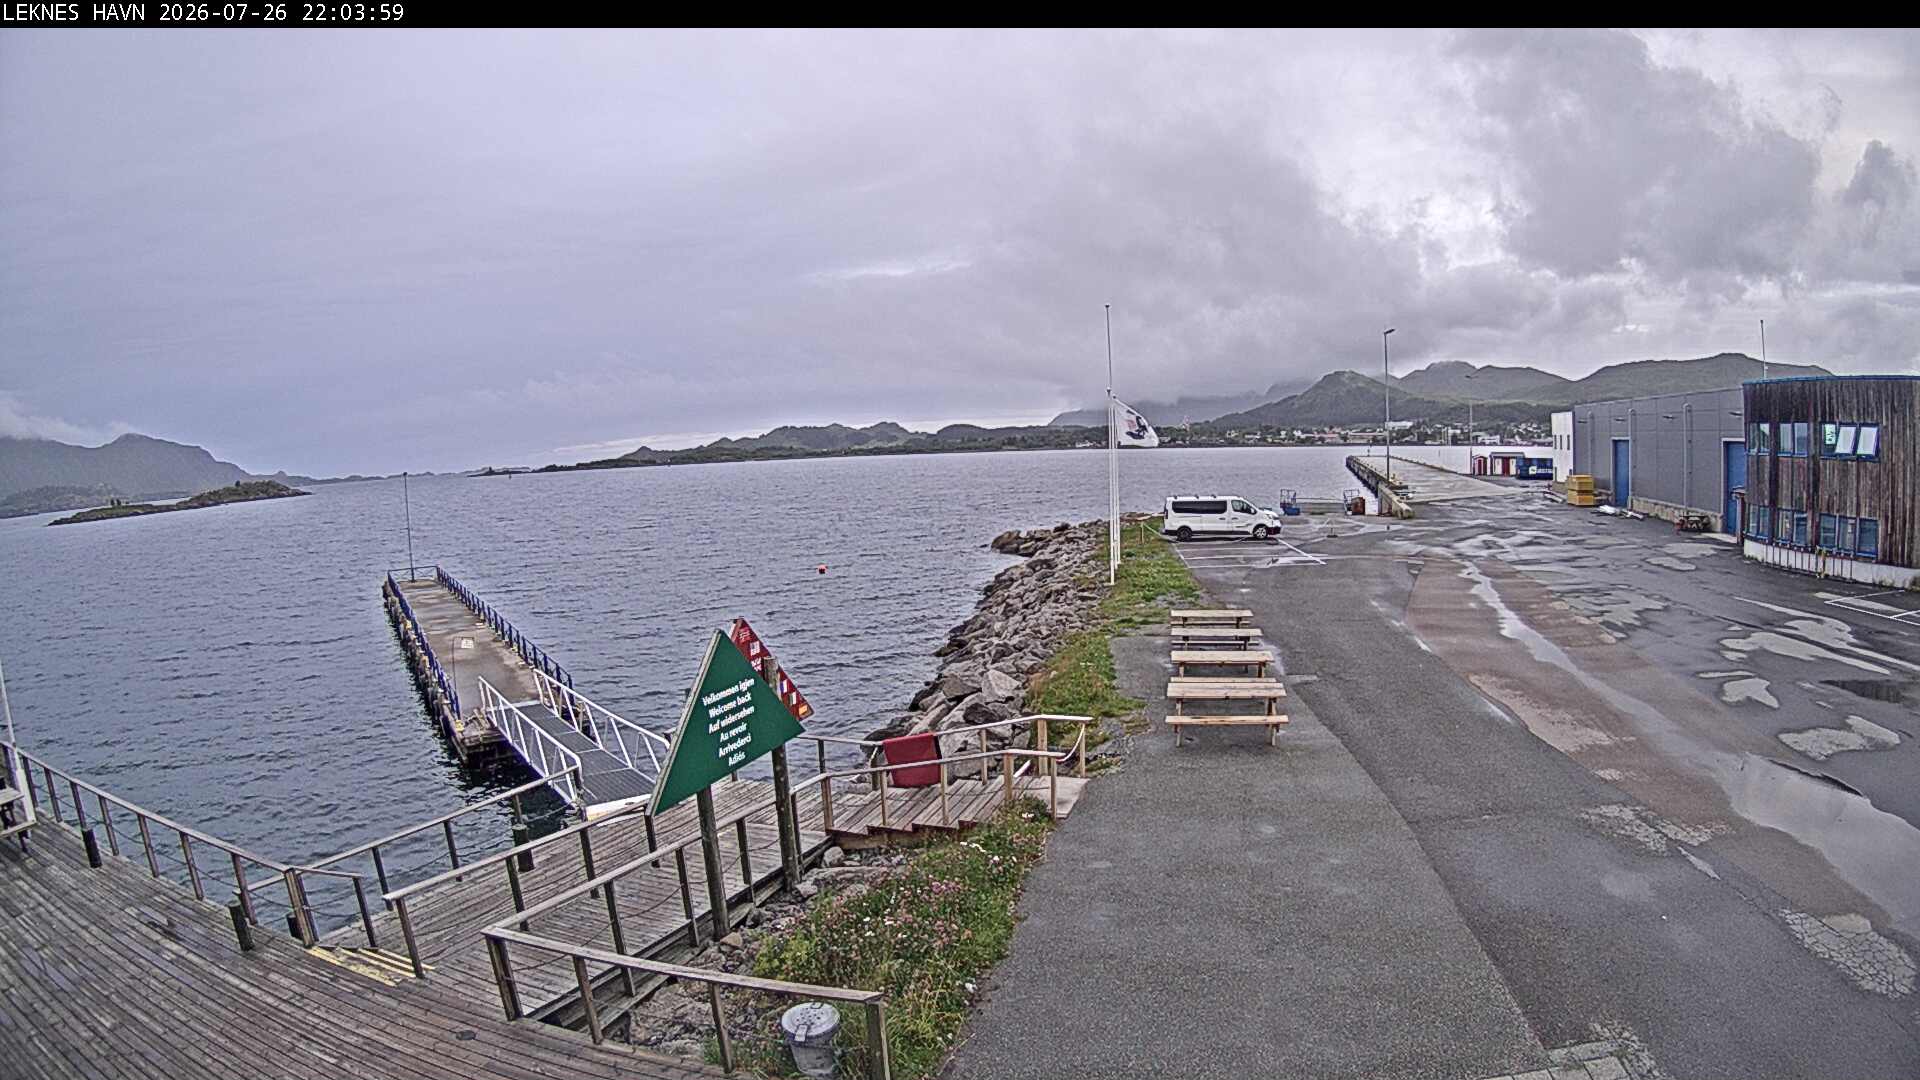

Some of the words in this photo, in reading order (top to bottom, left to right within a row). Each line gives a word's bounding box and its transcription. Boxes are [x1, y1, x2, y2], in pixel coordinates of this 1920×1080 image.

[702, 685, 738, 706] Velkommen
[739, 679, 755, 692] igjen
[708, 701, 737, 718] Welcome
[737, 691, 752, 706] back
[708, 719, 720, 734] Auf
[720, 732, 729, 742] Au
[729, 722, 747, 737] revoir
[718, 733, 752, 757] Arrivederci
